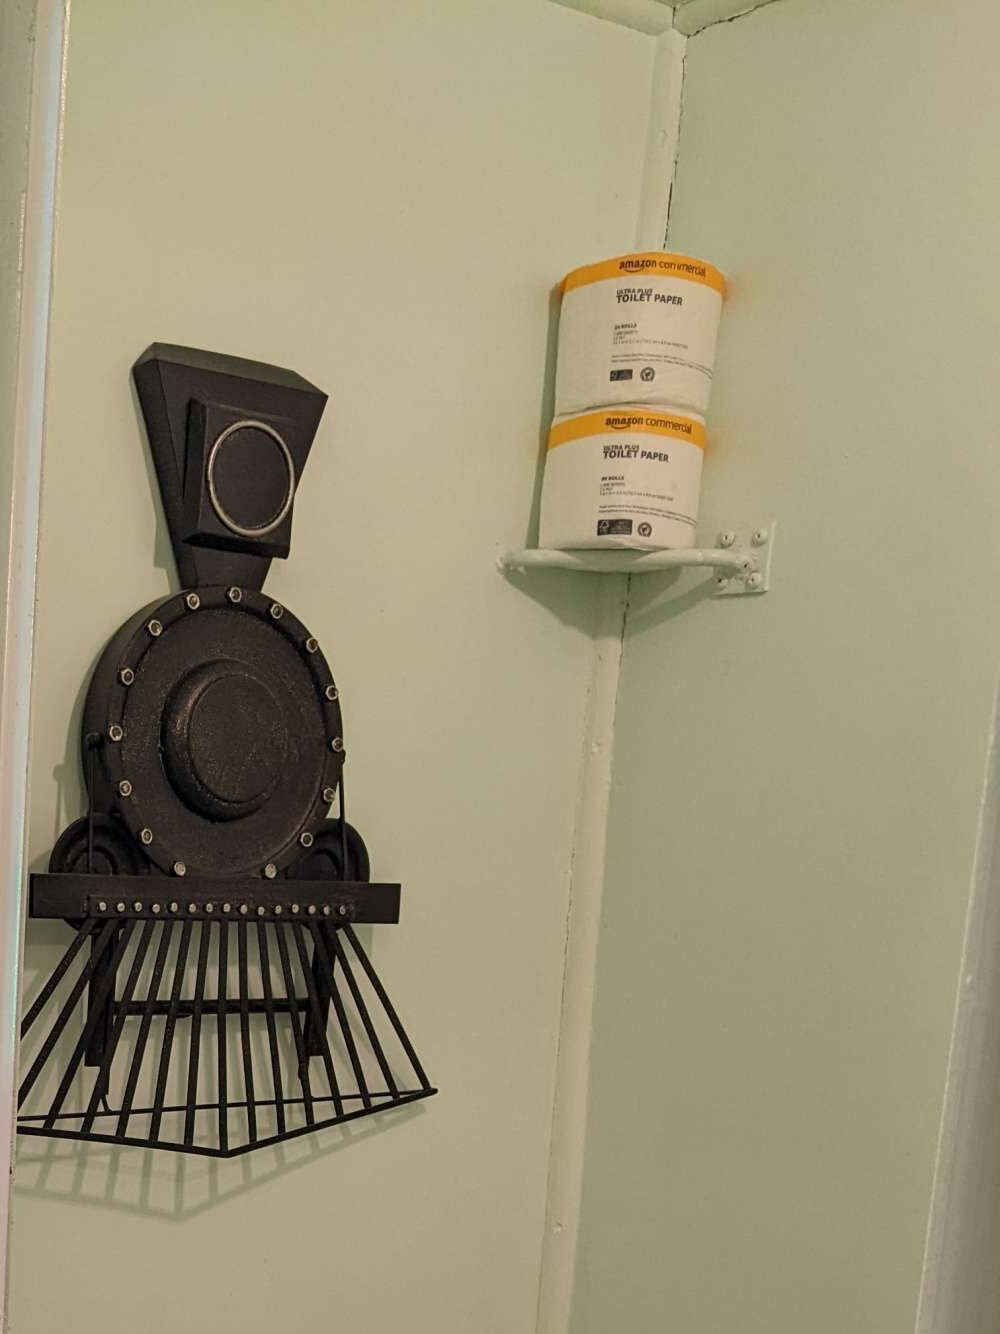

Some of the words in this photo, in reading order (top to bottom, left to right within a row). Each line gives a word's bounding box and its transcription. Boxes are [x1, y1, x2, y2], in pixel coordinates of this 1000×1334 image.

[618, 259, 657, 273] amazon
[658, 259, 706, 277] commercial
[616, 294, 652, 304] TOILET
[654, 294, 683, 306] PAPER
[605, 417, 644, 430] amazon
[645, 418, 692, 435] commercial
[603, 450, 638, 460] TOILET
[640, 450, 669, 463] PAPER
